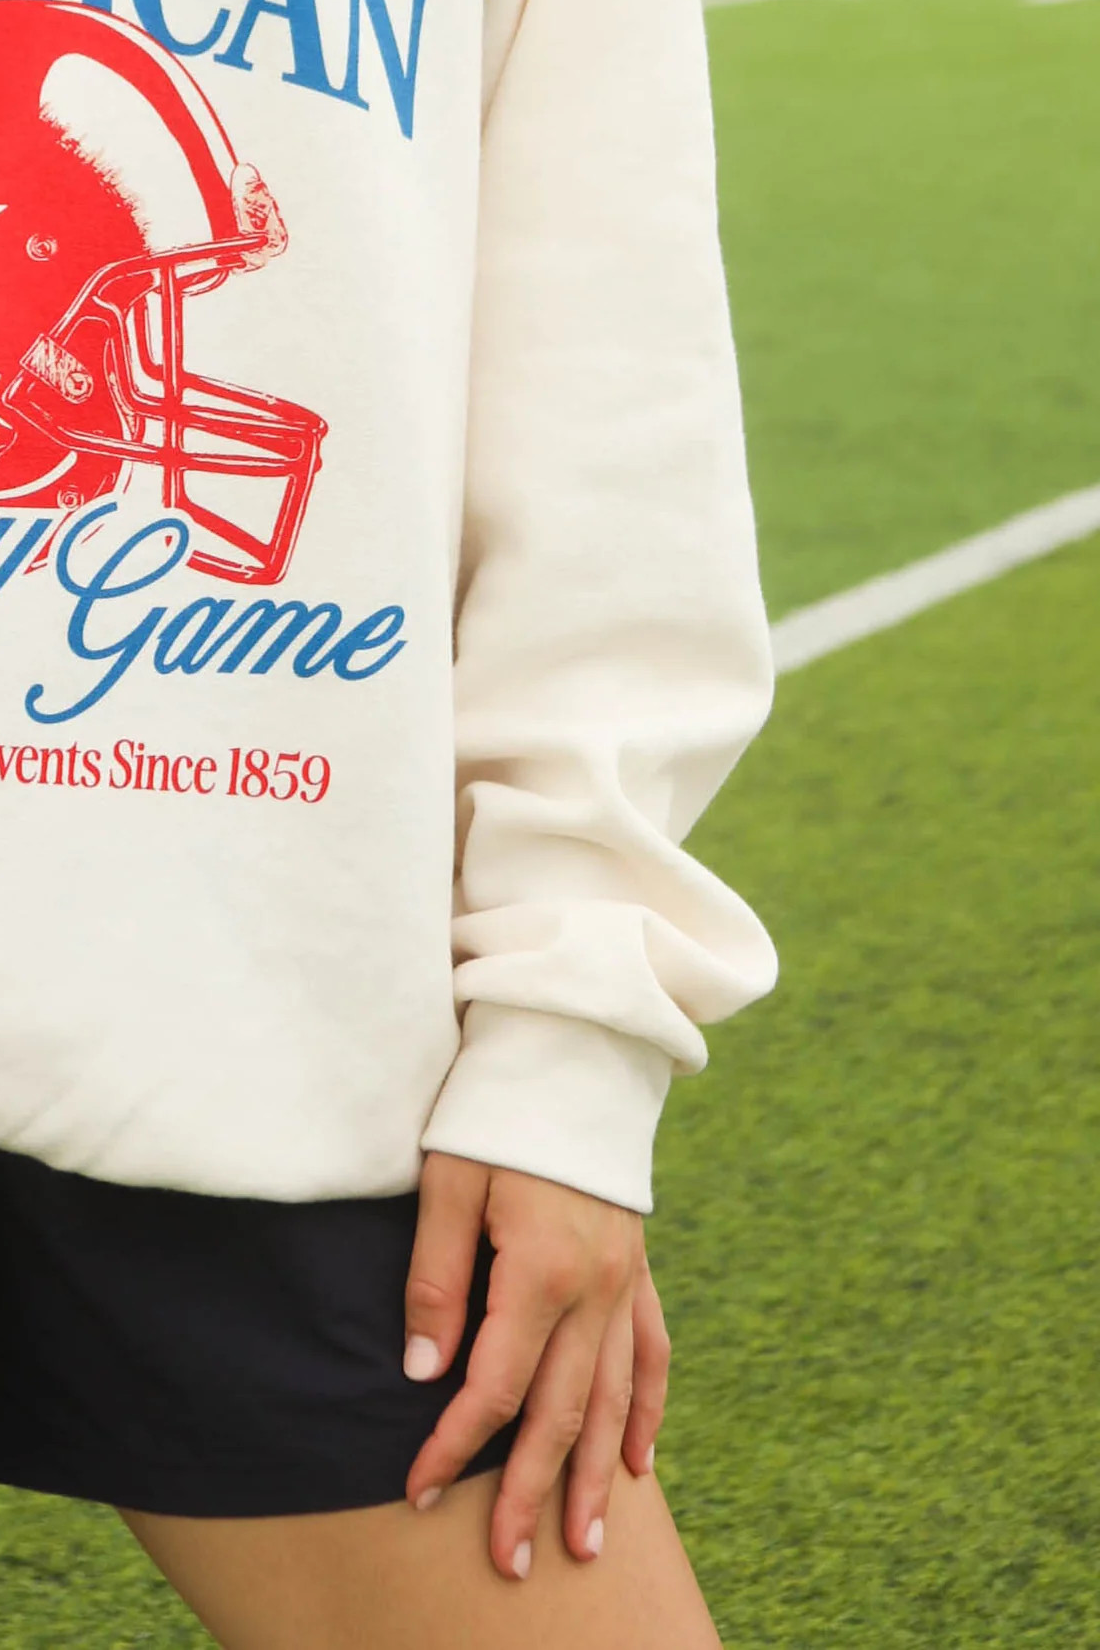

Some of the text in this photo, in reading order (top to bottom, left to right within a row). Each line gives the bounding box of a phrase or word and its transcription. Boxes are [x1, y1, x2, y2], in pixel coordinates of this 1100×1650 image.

[24, 502, 407, 725] Game
[106, 738, 218, 796] Since
[225, 746, 332, 805] 1859
